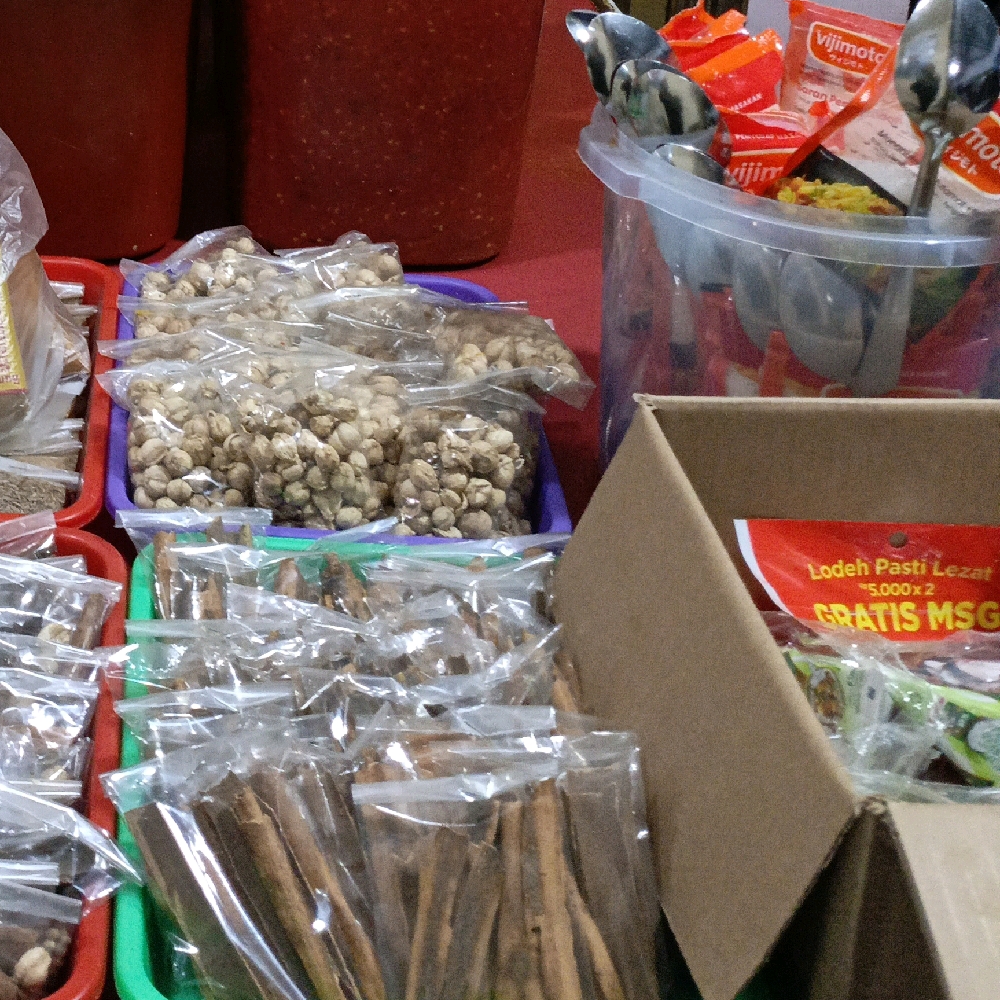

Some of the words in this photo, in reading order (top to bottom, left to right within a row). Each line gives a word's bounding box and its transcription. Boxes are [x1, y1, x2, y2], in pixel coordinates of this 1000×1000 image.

[808, 558, 870, 581] Lodeh
[875, 557, 927, 576] Pasti
[933, 558, 993, 582] Lezat
[813, 601, 922, 632] GRATIS
[928, 601, 1000, 631] MSG
